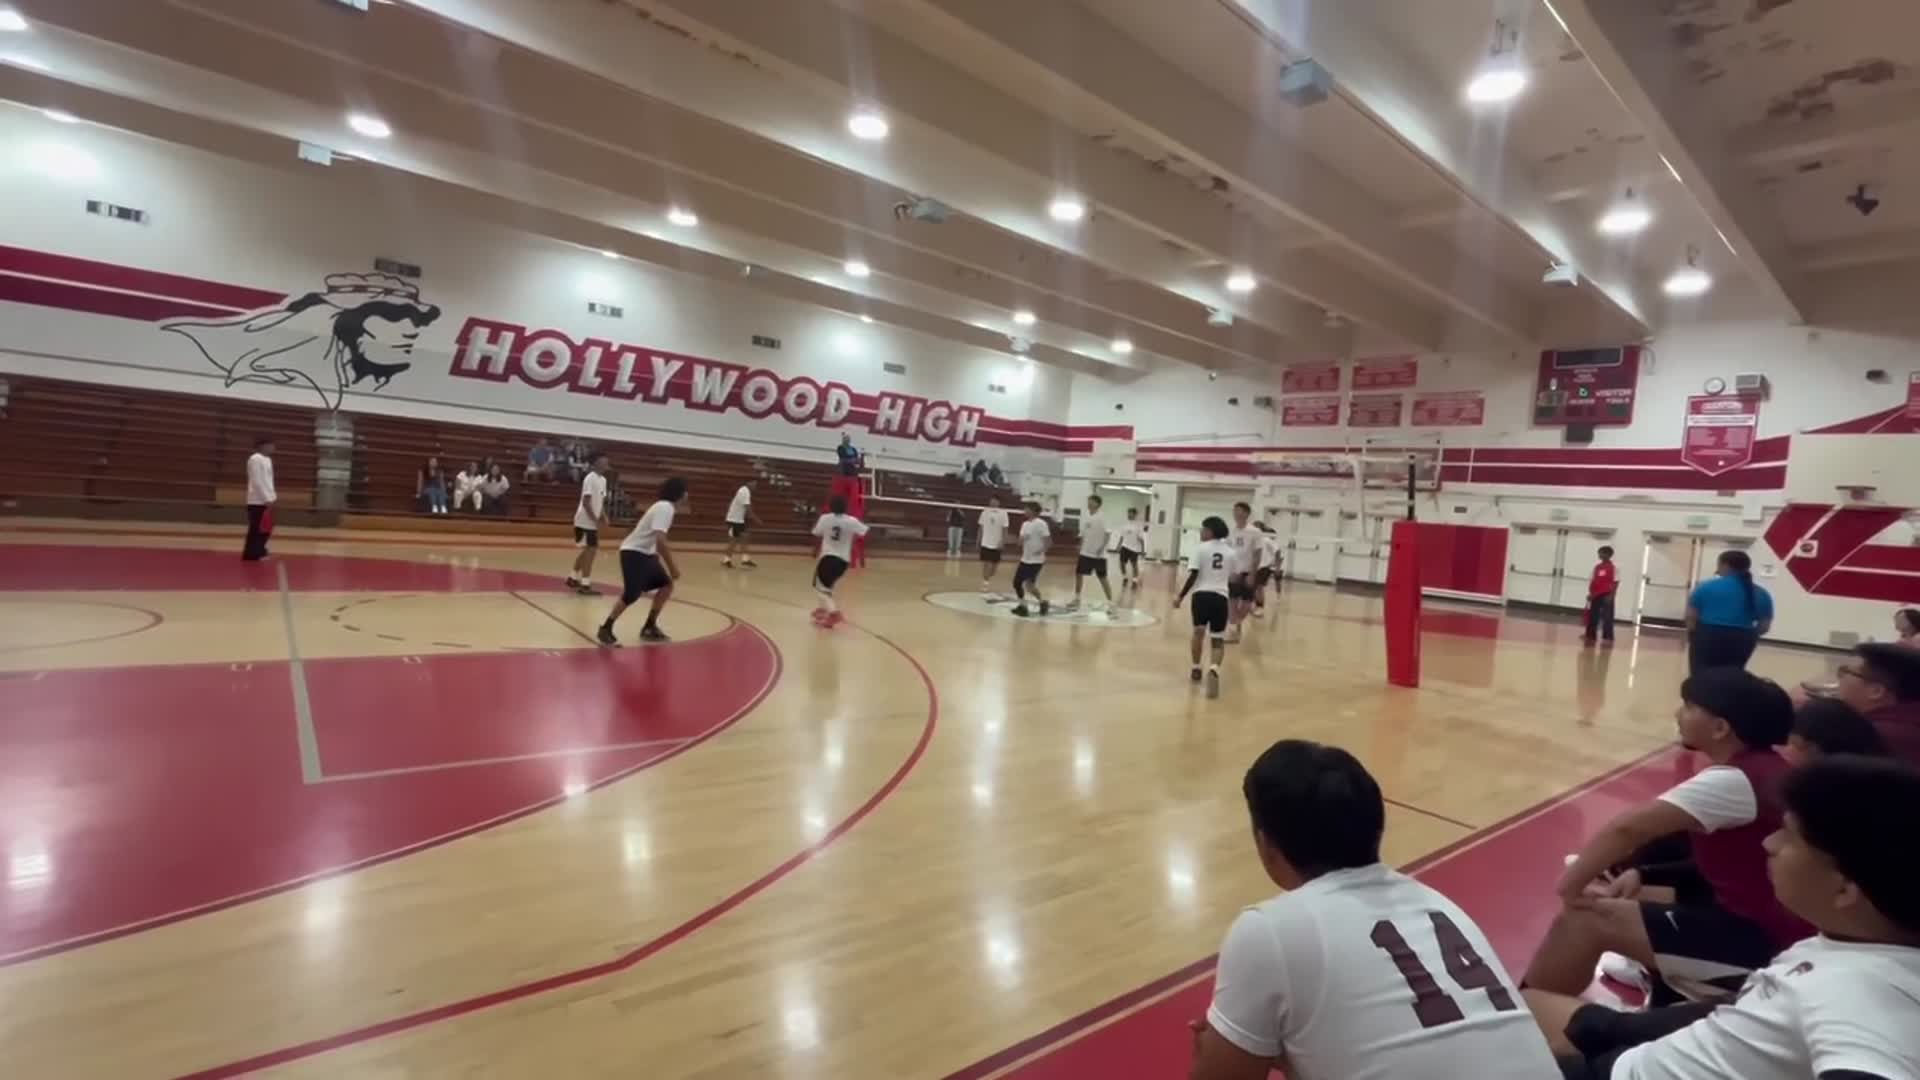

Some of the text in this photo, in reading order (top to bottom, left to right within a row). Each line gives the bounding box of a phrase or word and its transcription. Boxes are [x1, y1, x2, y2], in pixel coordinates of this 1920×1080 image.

[460, 326, 981, 444] HOLLYWOOD HIGH
[1212, 552, 1223, 569] 2
[1370, 911, 1517, 1028] 14
